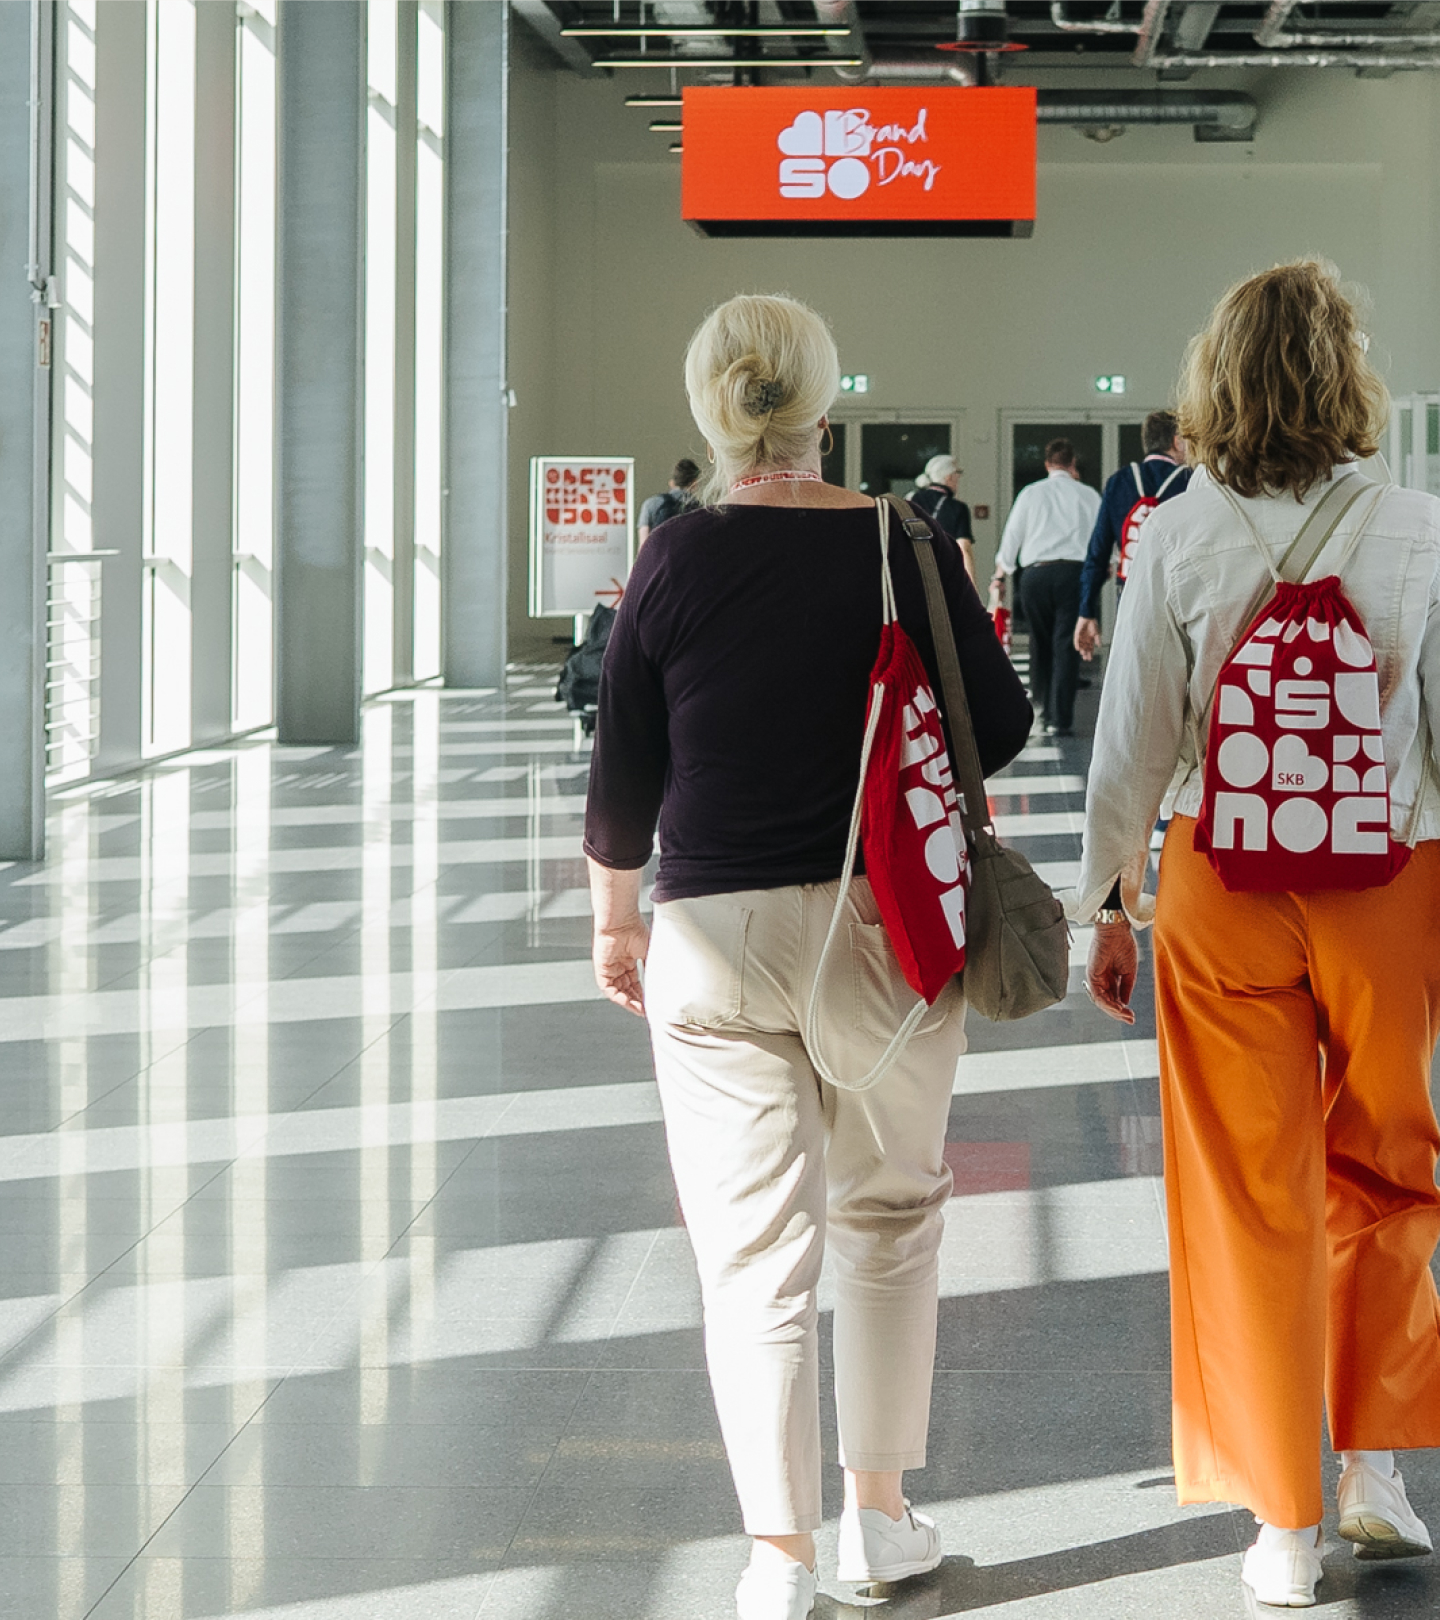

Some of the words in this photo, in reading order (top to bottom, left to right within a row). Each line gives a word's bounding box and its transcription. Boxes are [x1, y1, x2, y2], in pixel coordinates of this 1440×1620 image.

[836, 108, 928, 154] Brand
[870, 147, 941, 191] Day
[1277, 772, 1304, 786] SKB
